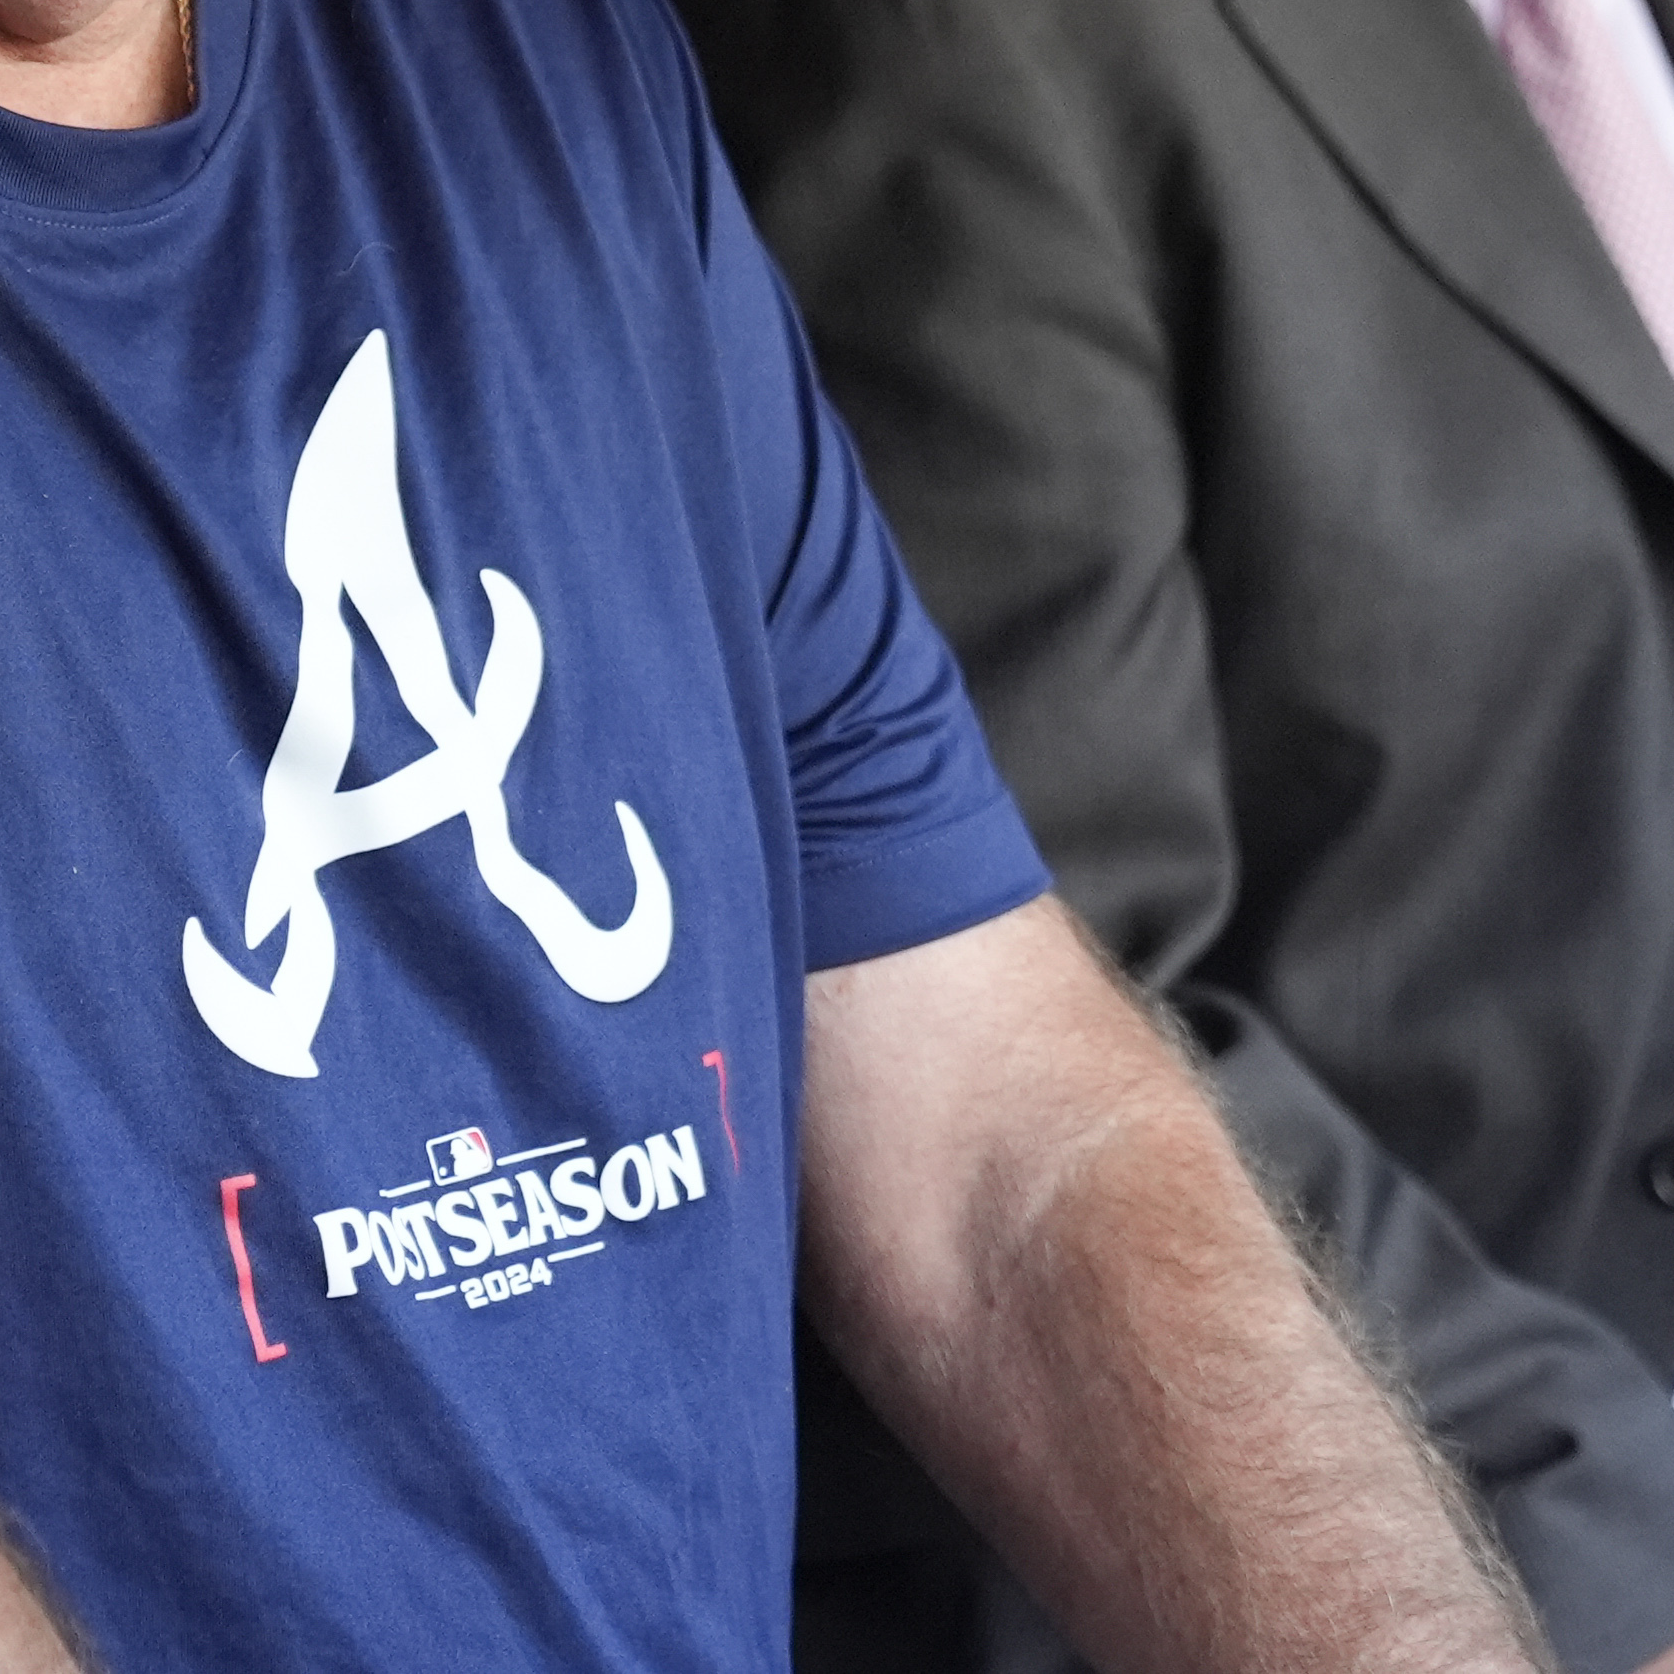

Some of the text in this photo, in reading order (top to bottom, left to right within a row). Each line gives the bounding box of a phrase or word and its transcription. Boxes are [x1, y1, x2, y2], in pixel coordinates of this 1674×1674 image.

[182, 327, 674, 1078] A
[313, 1124, 706, 1299] POSTSEASON
[459, 1256, 554, 1310] 2024
